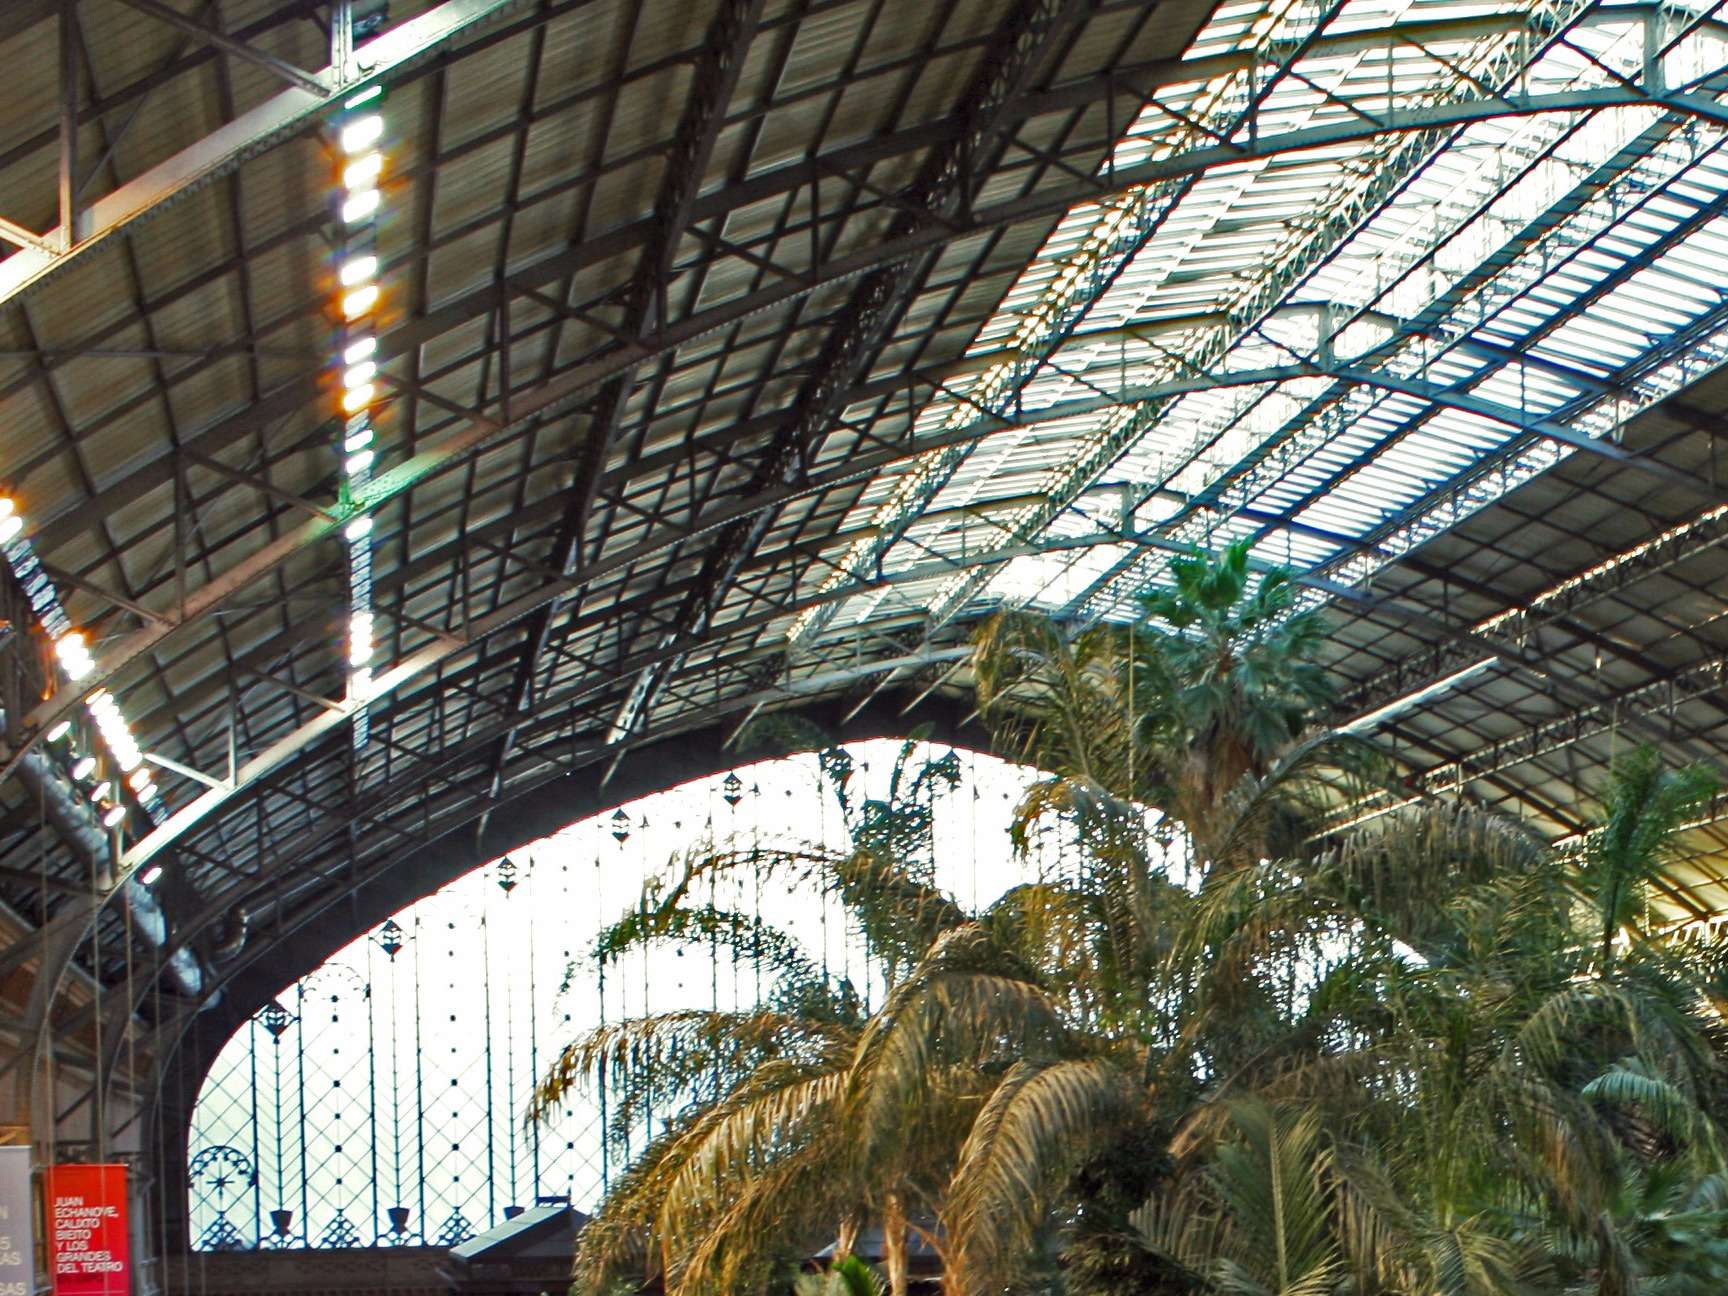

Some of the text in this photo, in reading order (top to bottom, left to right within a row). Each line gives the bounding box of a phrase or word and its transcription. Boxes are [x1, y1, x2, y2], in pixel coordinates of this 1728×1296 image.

[55, 1197, 83, 1207] JUAN
[55, 1206, 119, 1218] ECHANOVE,
[55, 1240, 88, 1252] Y LOS
[57, 1251, 112, 1263] GRANDES
[57, 1261, 123, 1274] DEL TEATRO
